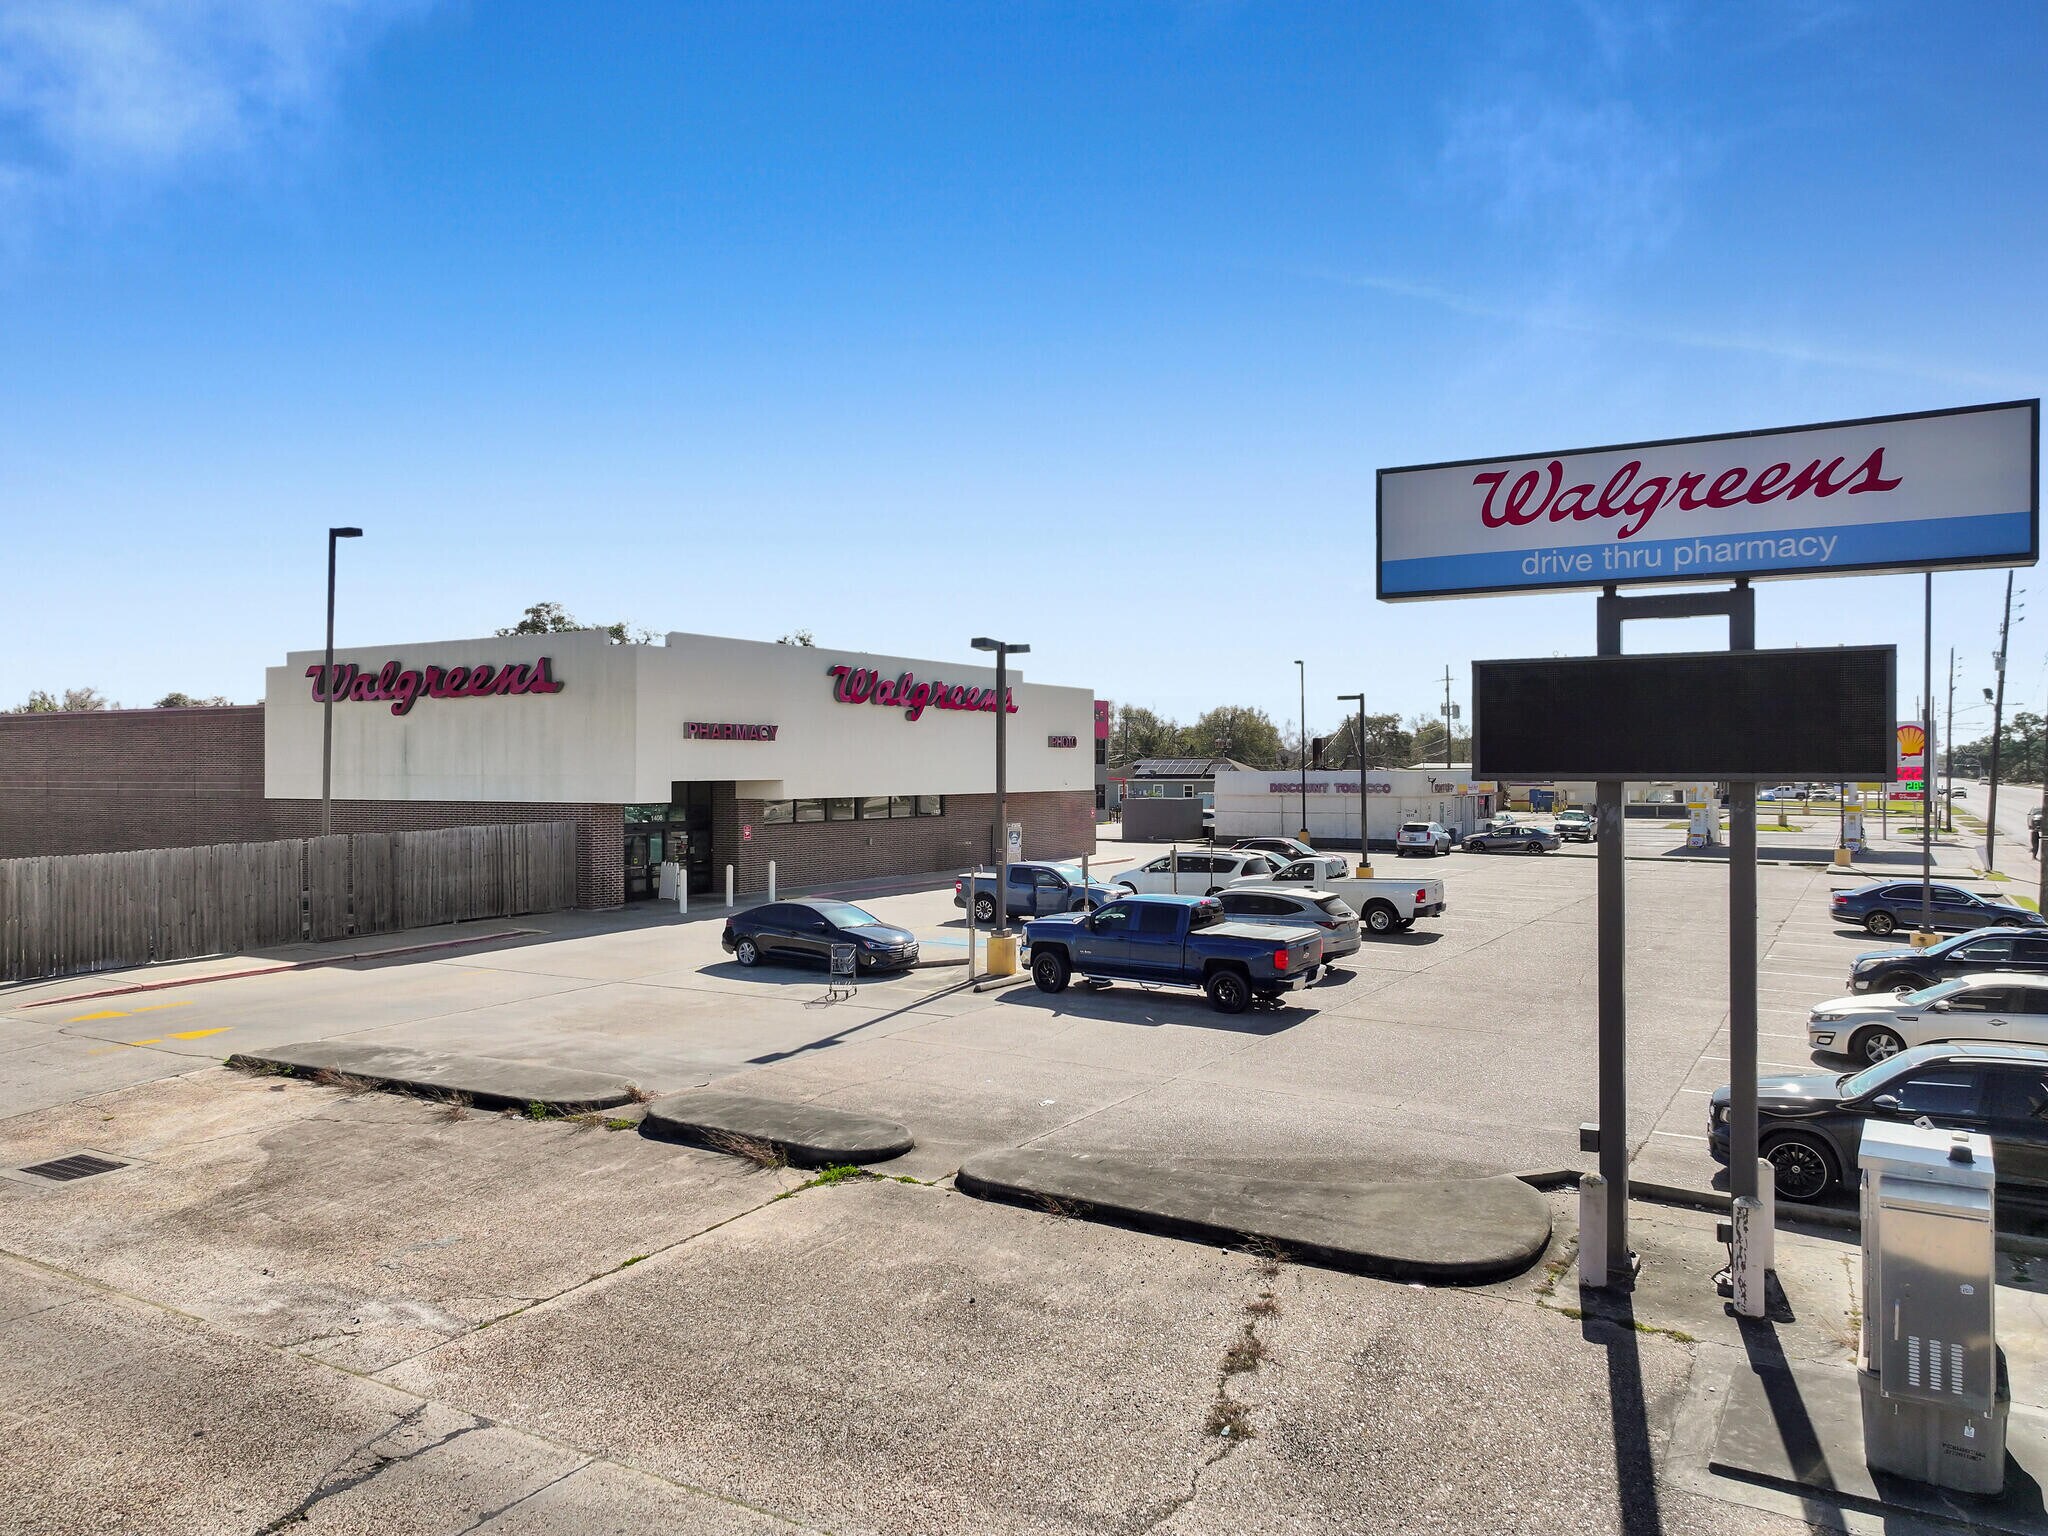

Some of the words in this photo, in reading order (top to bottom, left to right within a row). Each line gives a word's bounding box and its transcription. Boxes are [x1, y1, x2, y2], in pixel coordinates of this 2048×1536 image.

[1472, 446, 1904, 540] Walgreens
[1521, 551, 1593, 577] drive
[1602, 545, 1662, 569] thru
[1673, 534, 1839, 571] pharmacy
[305, 657, 565, 716] Walgreens
[828, 664, 1019, 721] Walgreens
[684, 722, 778, 741] PHARMACY
[1048, 735, 1078, 749] PHOTO
[1269, 782, 1329, 794] DISCOUNT
